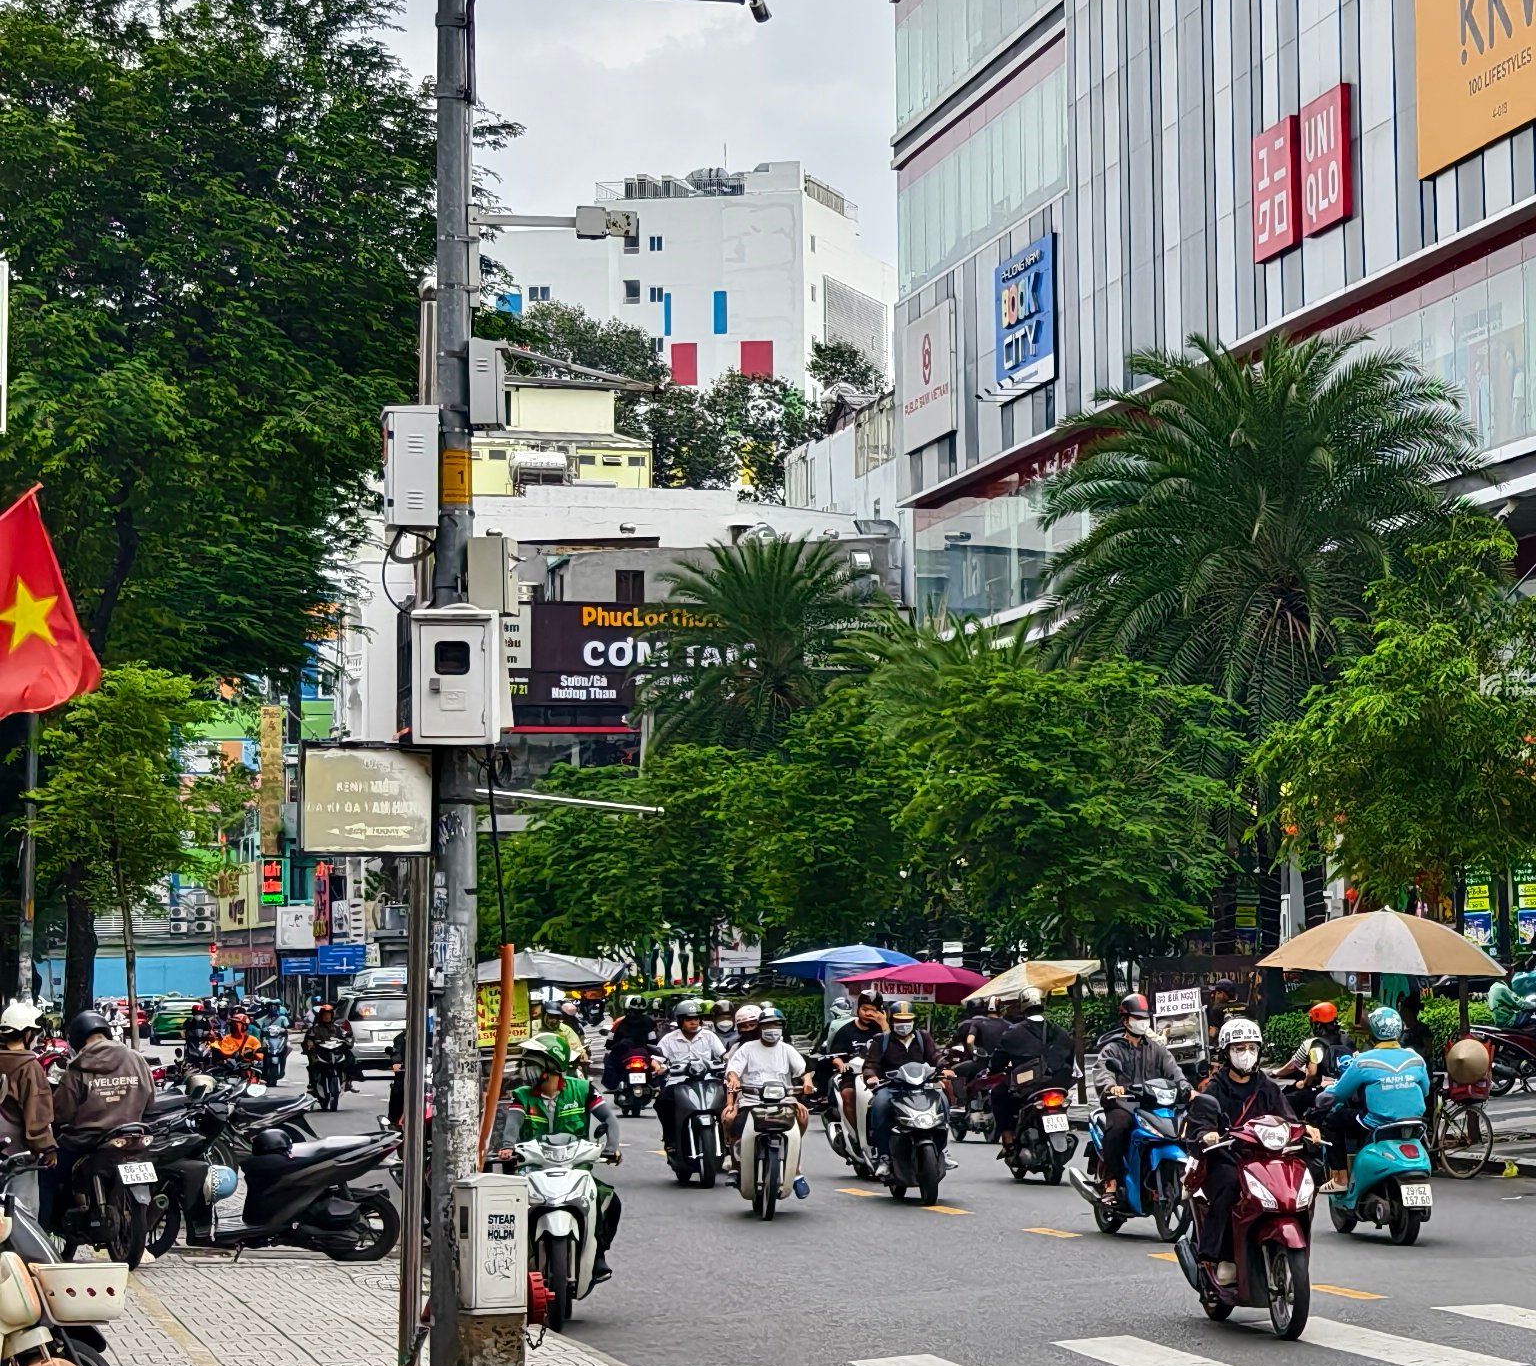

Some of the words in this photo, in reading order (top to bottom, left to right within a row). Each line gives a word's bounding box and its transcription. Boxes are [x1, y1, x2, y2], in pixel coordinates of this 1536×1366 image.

[1469, 75, 1483, 96] 100
[1484, 46, 1532, 88] LIFESTYLES
[1305, 106, 1336, 163] UNI
[1306, 164, 1339, 223] QLO
[1001, 272, 1041, 330] BOOK
[1003, 320, 1042, 371] CITY
[457, 470, 465, 485] 1
[488, 1214, 516, 1226] STEAR
